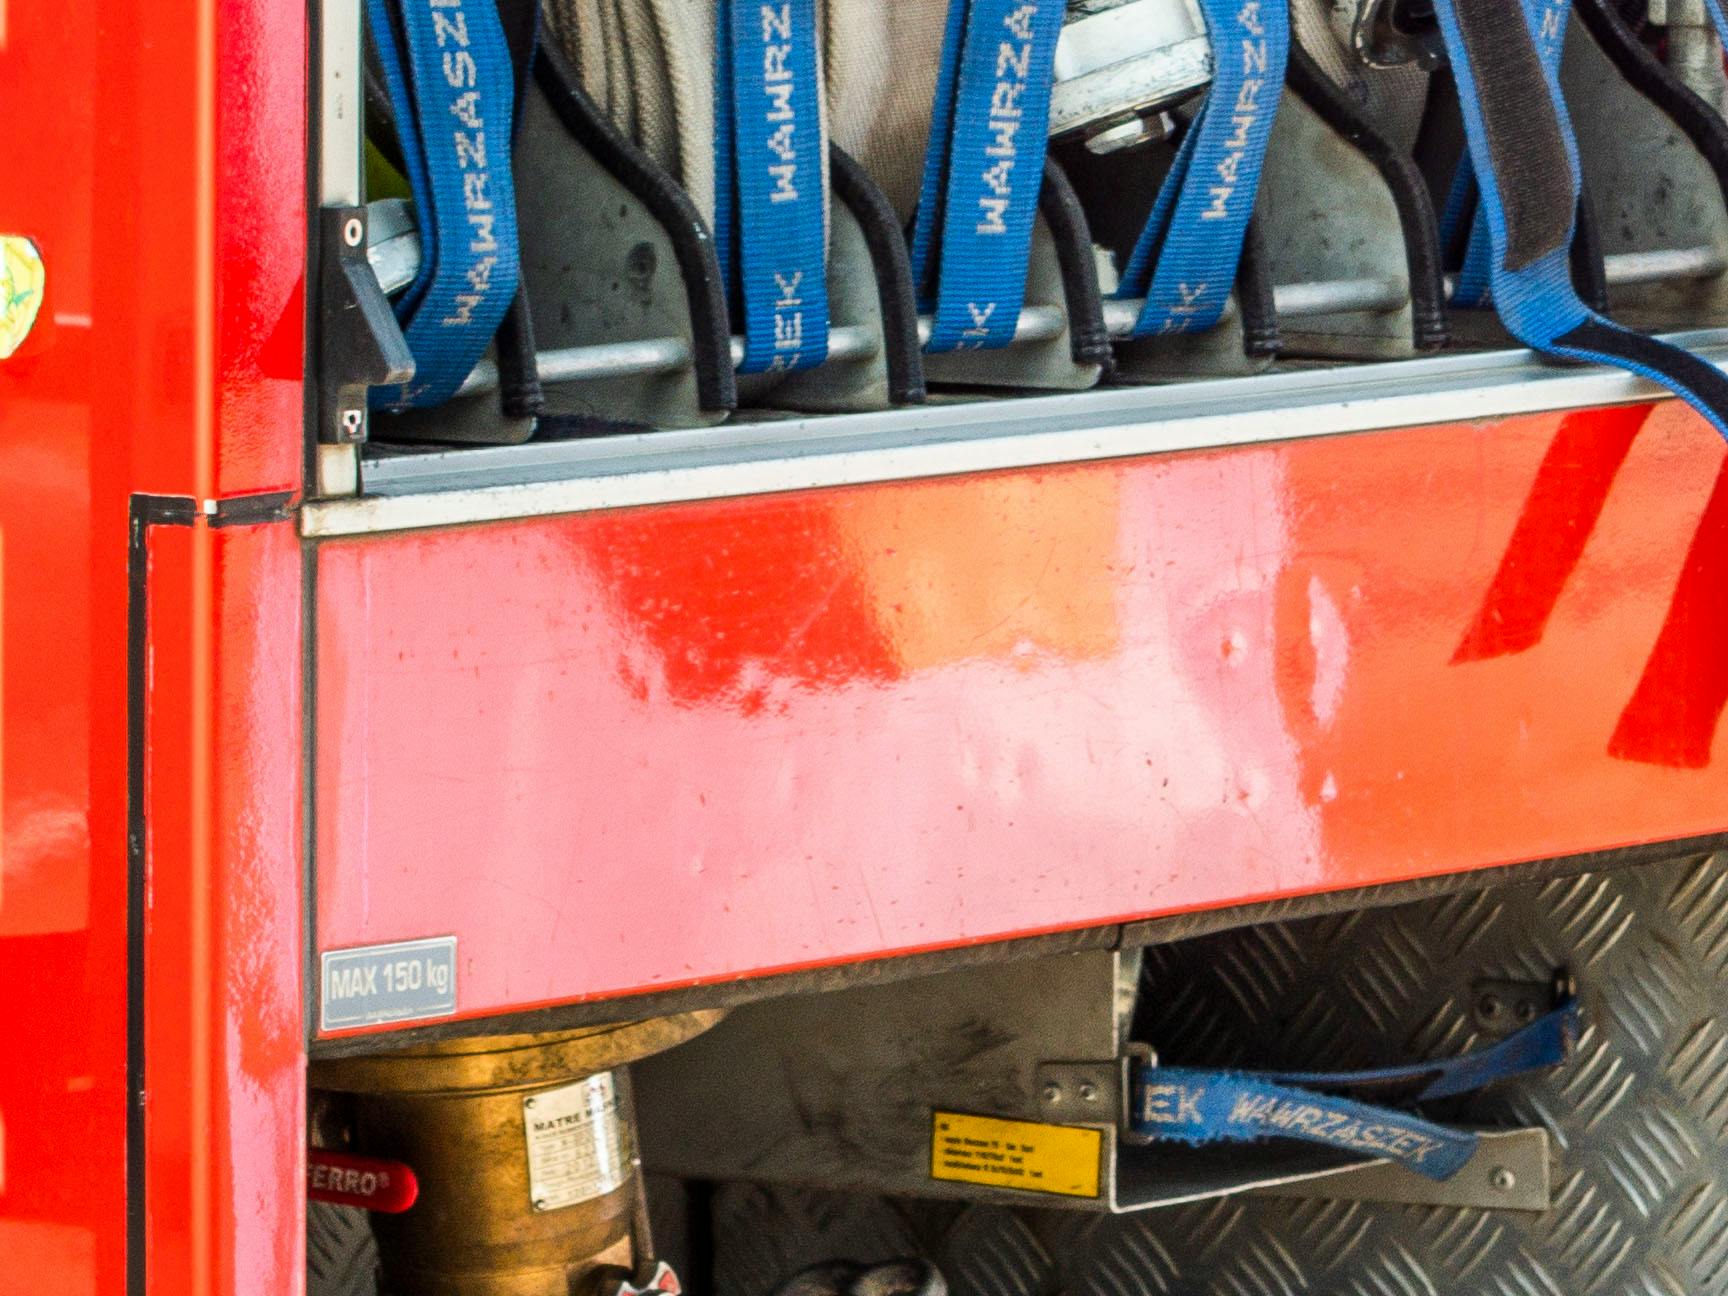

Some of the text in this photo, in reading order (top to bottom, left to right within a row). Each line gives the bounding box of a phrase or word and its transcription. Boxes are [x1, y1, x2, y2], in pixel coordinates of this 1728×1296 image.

[330, 958, 449, 1000] MAX 150 kg
[1228, 1091, 1444, 1165] WAWRZASZEK
